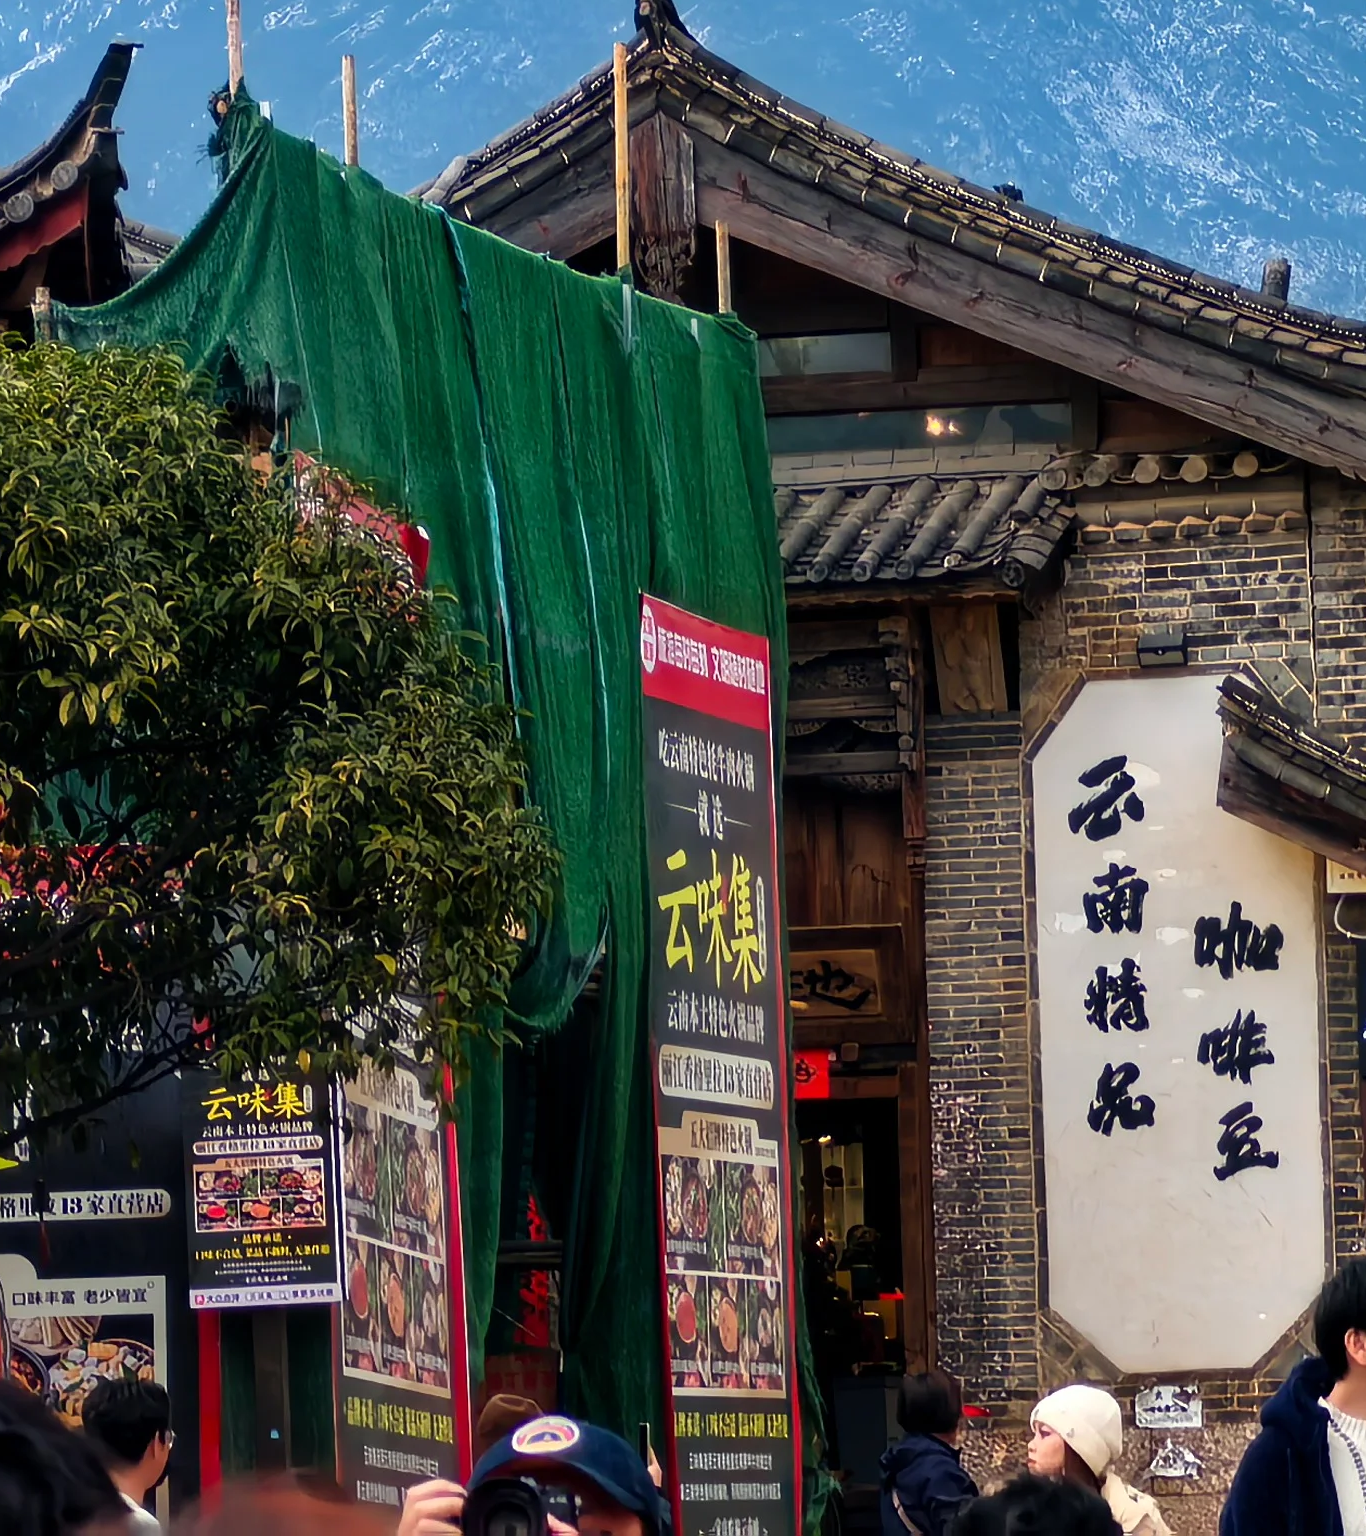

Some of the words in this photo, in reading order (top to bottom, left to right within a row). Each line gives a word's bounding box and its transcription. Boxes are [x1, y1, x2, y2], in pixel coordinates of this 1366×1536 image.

[658, 848, 762, 994] 云味集
[1068, 754, 1156, 1137] 云南精品
[667, 989, 766, 1046] 云南本土特色火锅品牌
[1193, 902, 1285, 1182] 咖啡豆
[201, 1081, 306, 1122] 云味集
